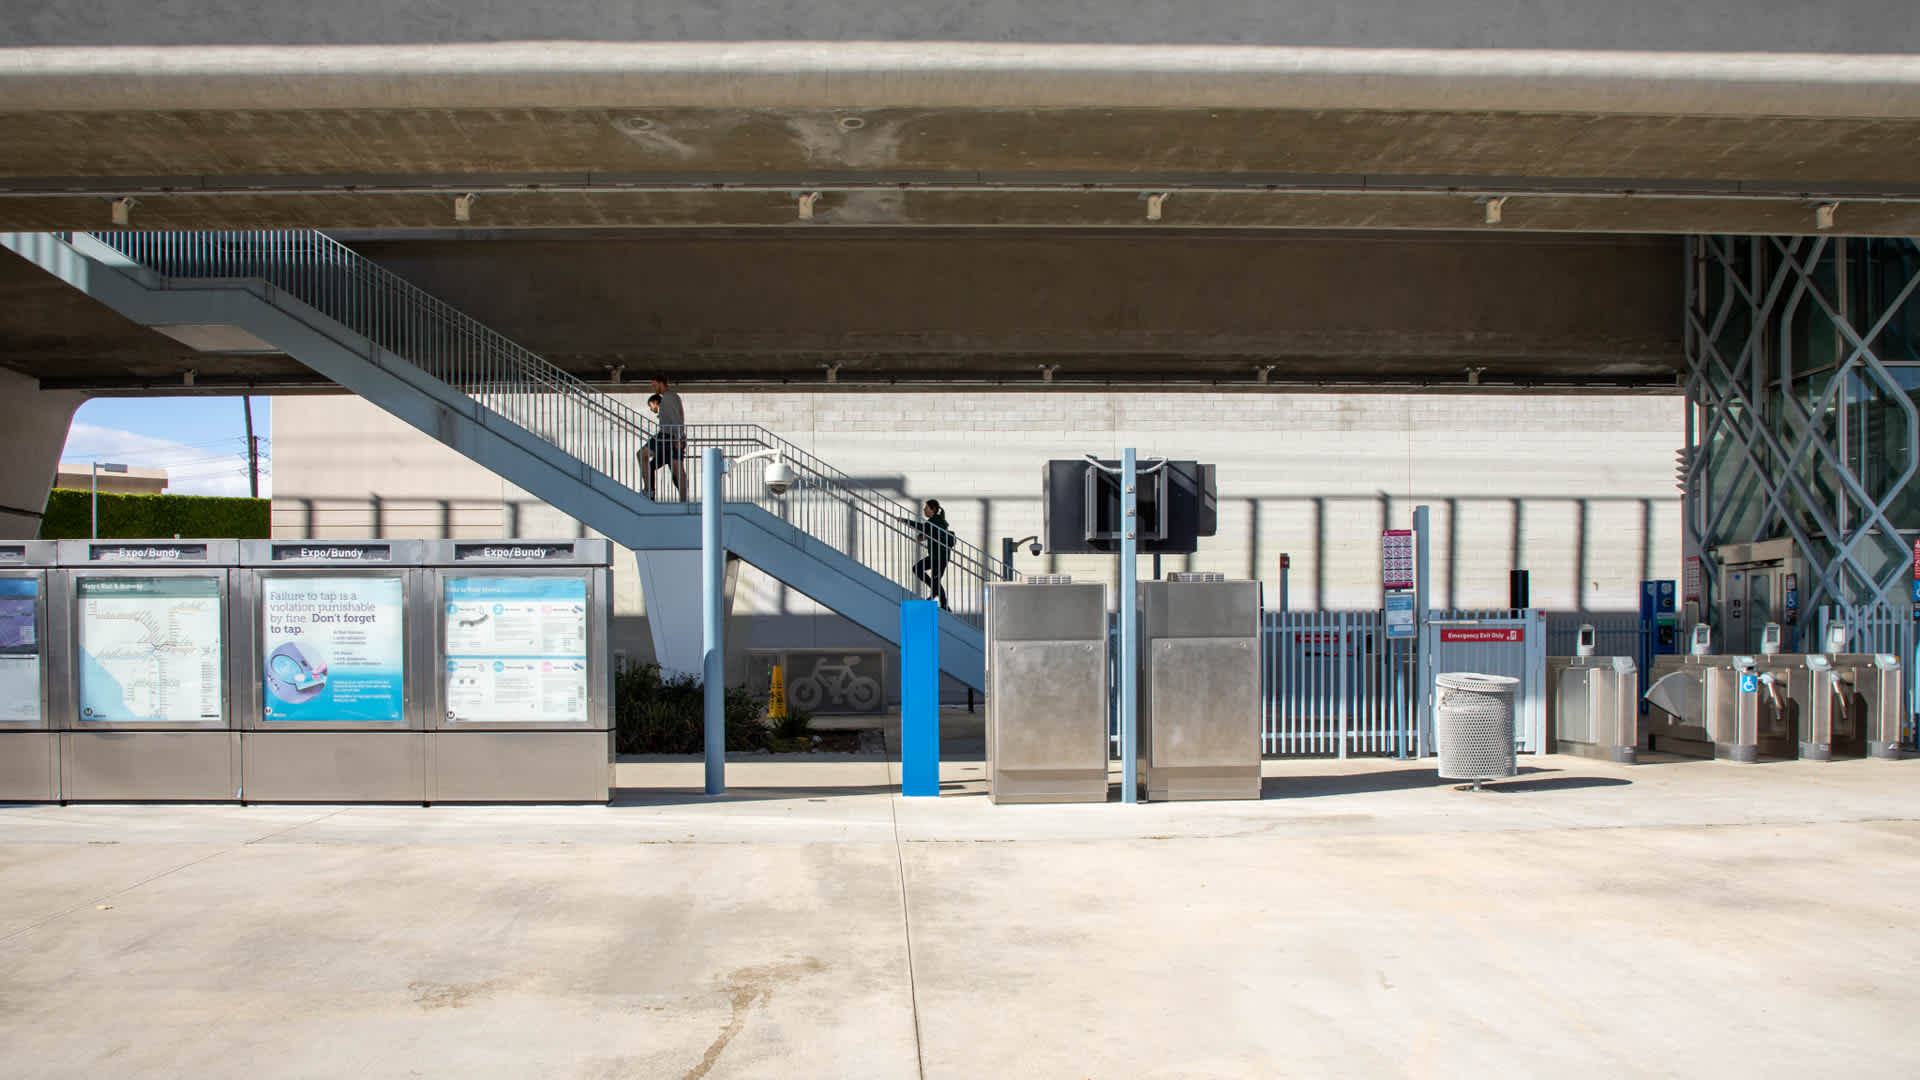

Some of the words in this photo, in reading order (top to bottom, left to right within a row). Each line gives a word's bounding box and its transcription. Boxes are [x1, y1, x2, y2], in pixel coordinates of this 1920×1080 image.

[119, 547, 181, 559] Expo/Bundy
[300, 547, 364, 559] Expo/Bundy
[484, 547, 547, 559] Expo/Bundy
[270, 591, 305, 601] Failure
[307, 592, 318, 601] to
[321, 592, 337, 604] tap
[340, 591, 348, 601] is
[350, 593, 357, 601] a
[270, 602, 315, 612] violation
[318, 602, 376, 615] punishable
[270, 613, 284, 625] by
[311, 613, 341, 623] Don't
[343, 613, 377, 625] forget
[270, 624, 281, 634] to
[284, 624, 304, 636] tap.
[1447, 632, 1479, 640] Emergency
[1480, 632, 1491, 640] Exit
[1492, 632, 1504, 641] Only
